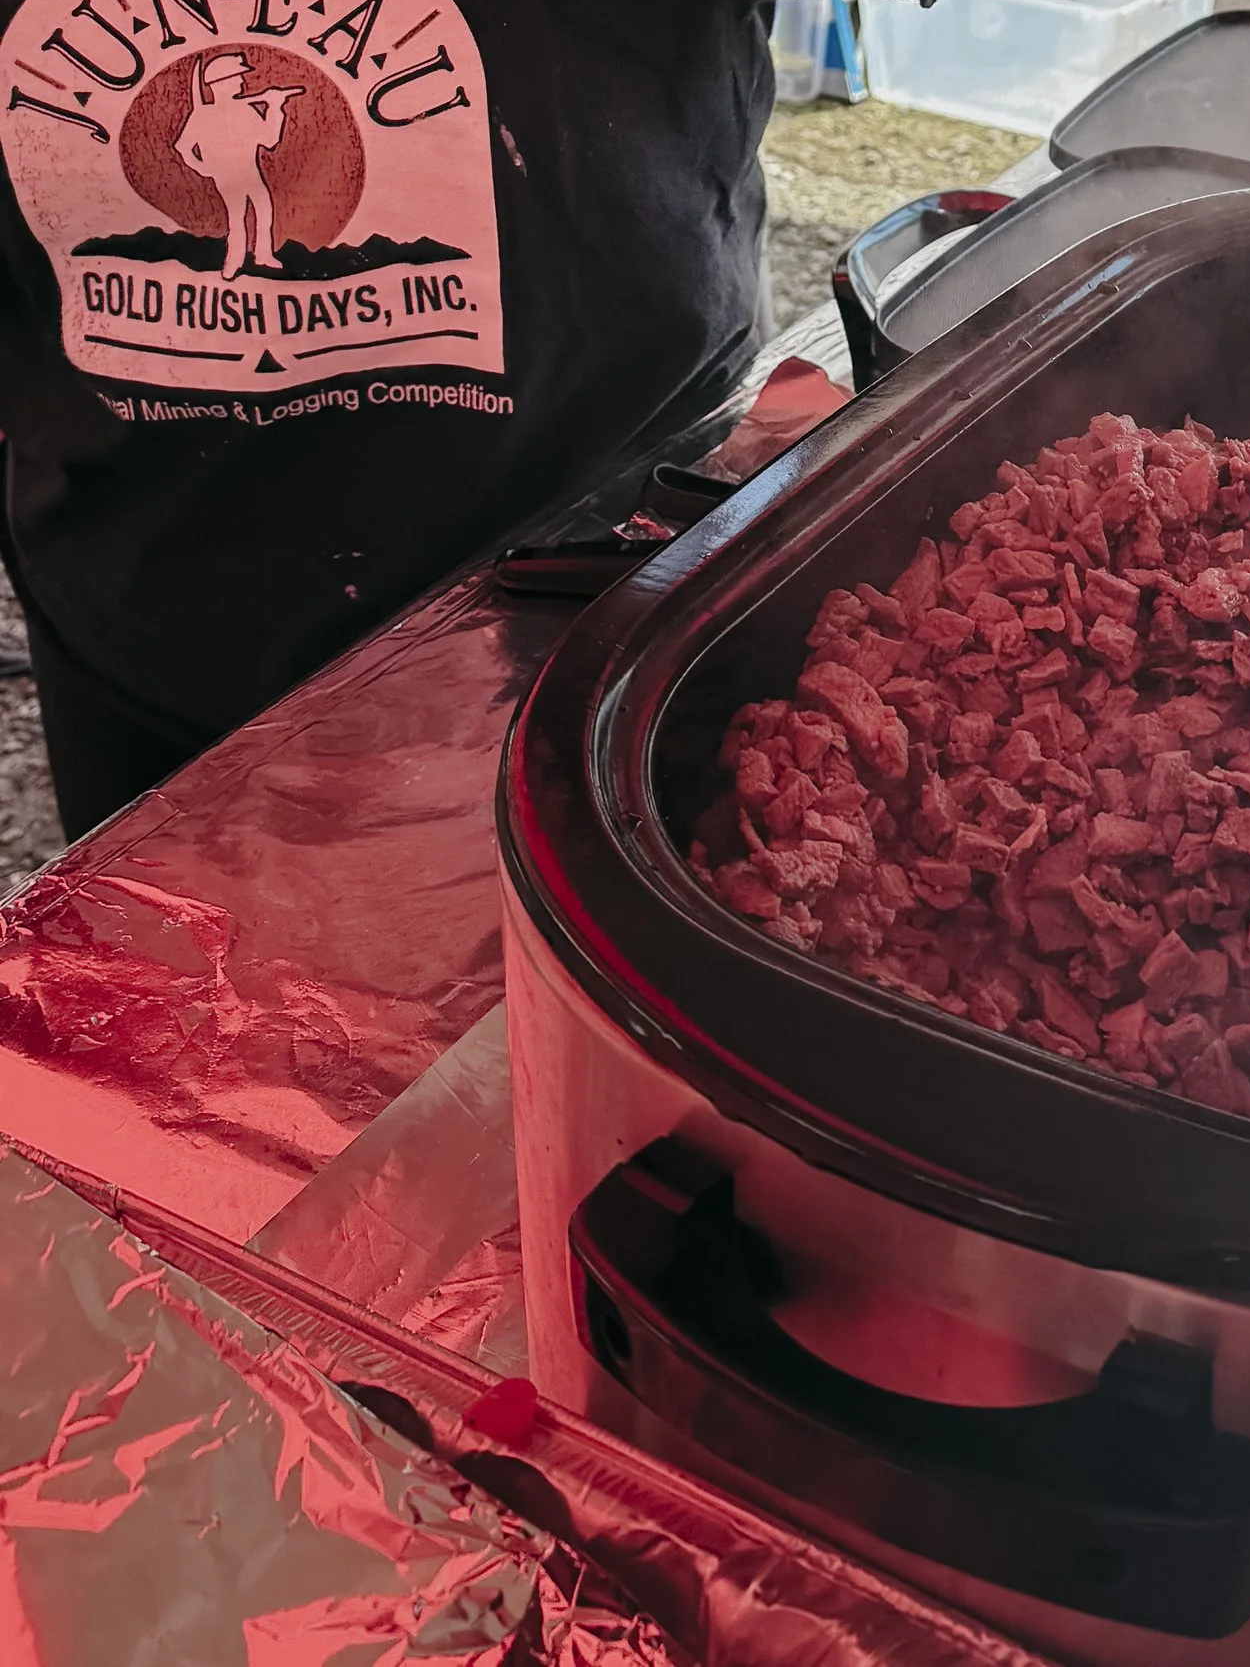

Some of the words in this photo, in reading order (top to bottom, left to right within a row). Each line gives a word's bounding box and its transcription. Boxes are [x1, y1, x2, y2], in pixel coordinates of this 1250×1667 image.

[82, 271, 164, 323] GOLD
[175, 282, 267, 335] RUSH
[276, 284, 393, 335] DAYS,
[401, 273, 478, 316] INC.
[254, 386, 361, 427] Logging
[367, 381, 514, 415] Competition
